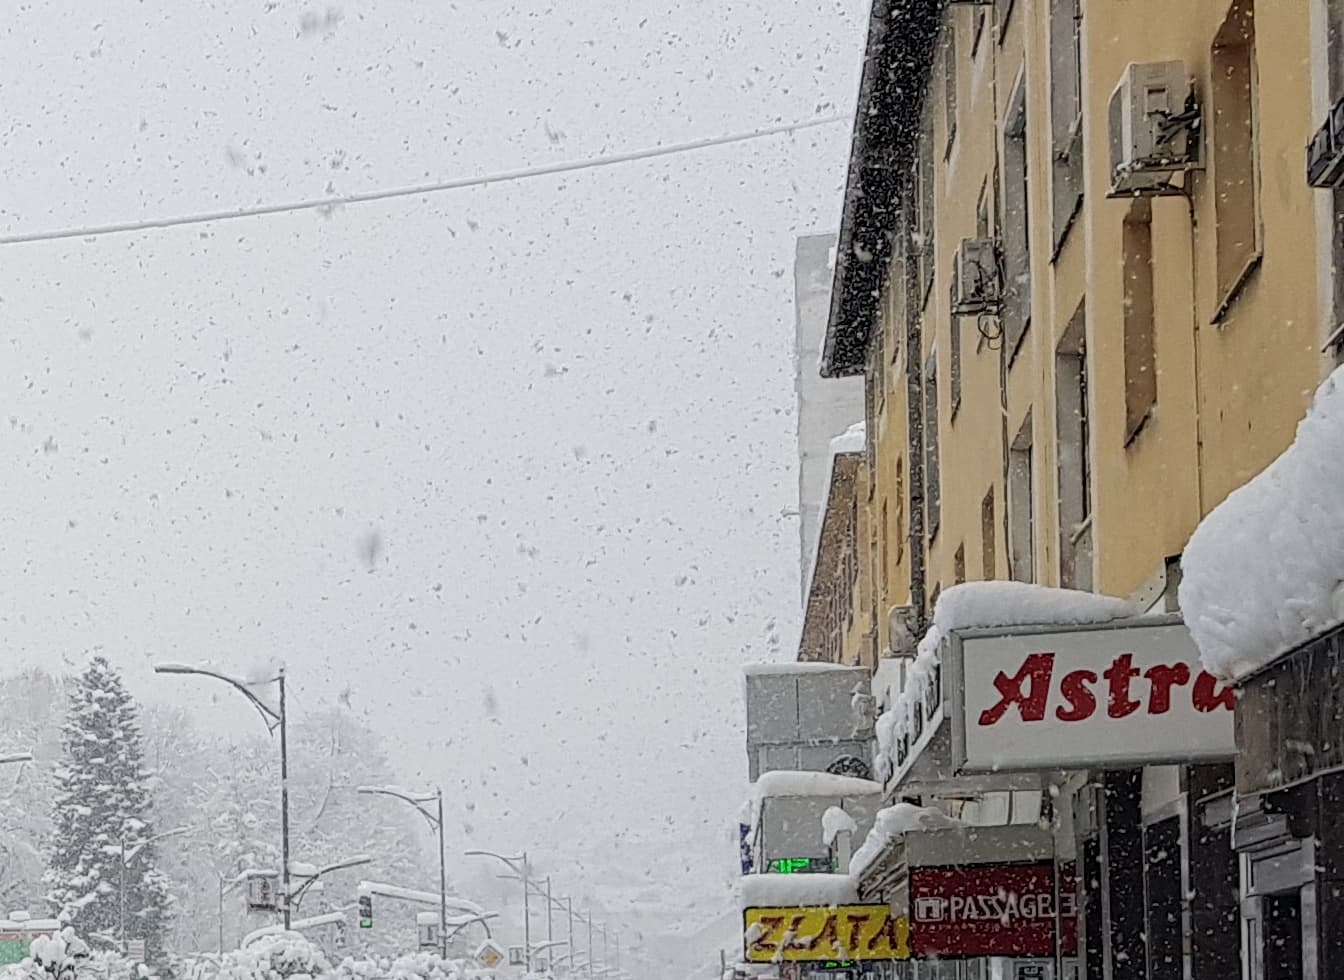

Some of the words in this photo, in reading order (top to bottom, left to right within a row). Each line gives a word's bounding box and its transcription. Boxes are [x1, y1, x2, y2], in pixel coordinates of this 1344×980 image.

[978, 652, 1235, 726] Astra
[951, 893, 1055, 922] PASSAGE
[751, 914, 911, 951] ZLATA
